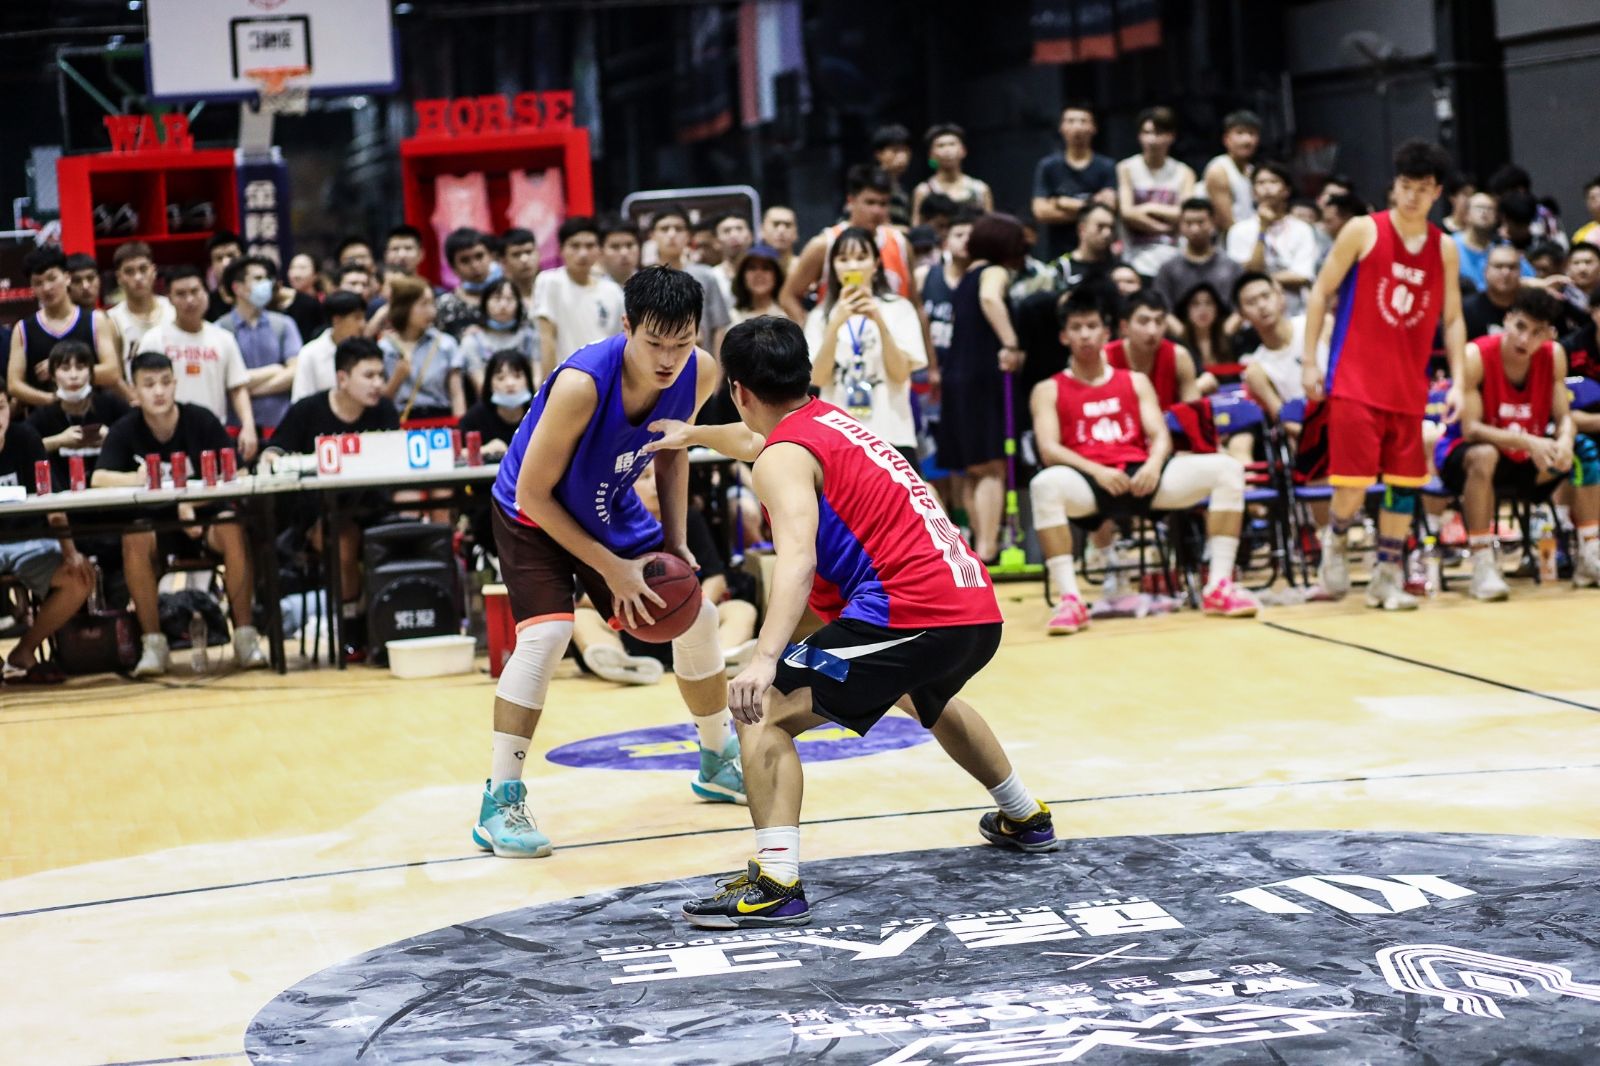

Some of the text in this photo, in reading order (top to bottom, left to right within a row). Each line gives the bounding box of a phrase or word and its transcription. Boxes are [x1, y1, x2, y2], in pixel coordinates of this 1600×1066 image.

[103, 90, 574, 155] WAR HORSE
[164, 345, 219, 361] CHINA
[320, 438, 340, 472] 0
[408, 433, 428, 468] 0
[948, 905, 1053, 920] KING
[1064, 896, 1152, 909] THE
[596, 923, 865, 955] UNDERDOGS
[790, 976, 1320, 1041] WAR HORSE
